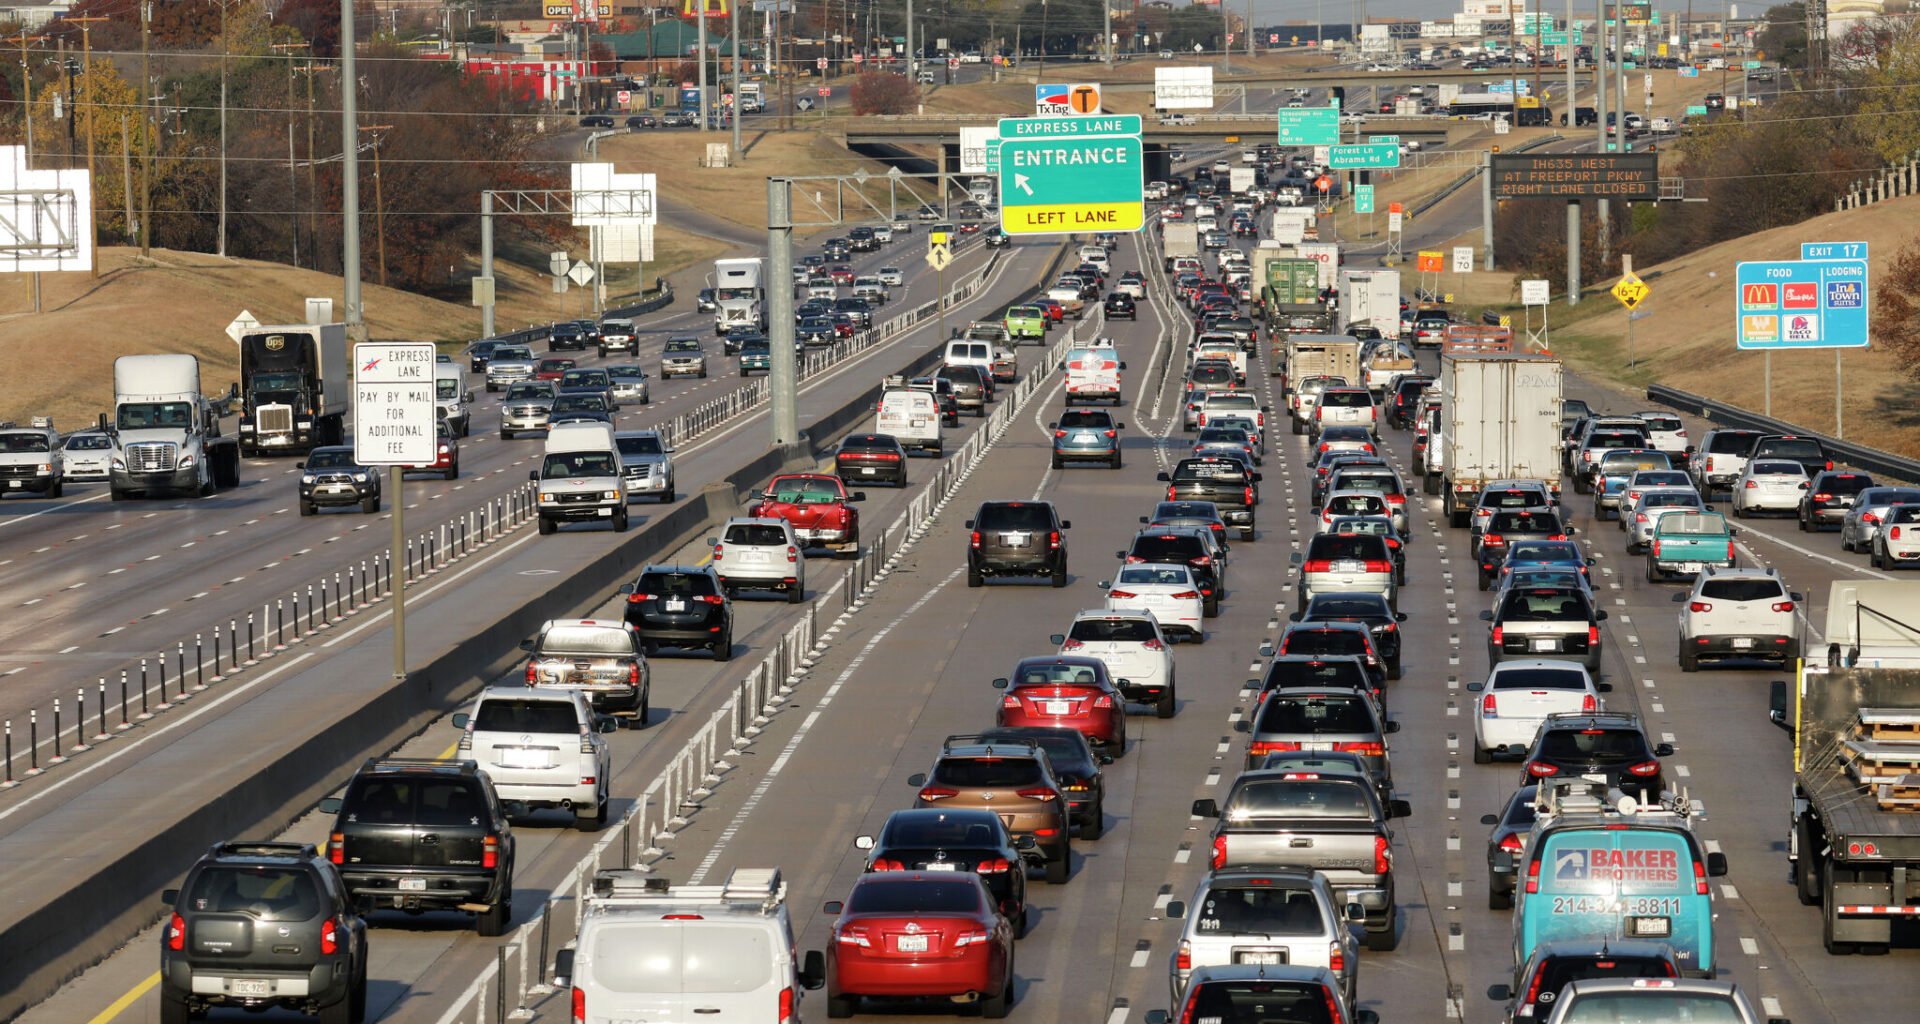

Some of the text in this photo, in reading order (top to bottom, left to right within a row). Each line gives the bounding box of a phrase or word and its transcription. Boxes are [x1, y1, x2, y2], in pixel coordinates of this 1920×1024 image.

[548, 6, 608, 14] OPEN RS
[1076, 89, 1092, 112] T
[1038, 104, 1068, 116] TxTag
[1017, 120, 1122, 134] EXPRESS LANE
[1014, 148, 1127, 166] ENTRANCE
[1533, 158, 1615, 169] IH635 WEST
[1505, 171, 1642, 181] AT FREEPORT PKWY
[1503, 183, 1646, 194] RIGHT LANE CLOSED
[1028, 211, 1117, 225] LEFT LANE
[1809, 245, 1858, 257] EXIT 17
[1767, 267, 1862, 278] FOOD LODGING
[1617, 286, 1641, 296] 16-7
[1836, 283, 1847, 293] In
[1830, 291, 1860, 301] Town
[266, 338, 284, 349] ups
[389, 351, 430, 362] EXPRESS
[398, 366, 420, 377] LANE
[360, 392, 430, 403] PAY BY MAIL
[387, 409, 403, 420] FOR
[369, 426, 422, 436] ADDITIONAL
[388, 443, 403, 453] FEE
[1591, 849, 1677, 868] BAKER
[1591, 868, 1678, 881] BROTHERS
